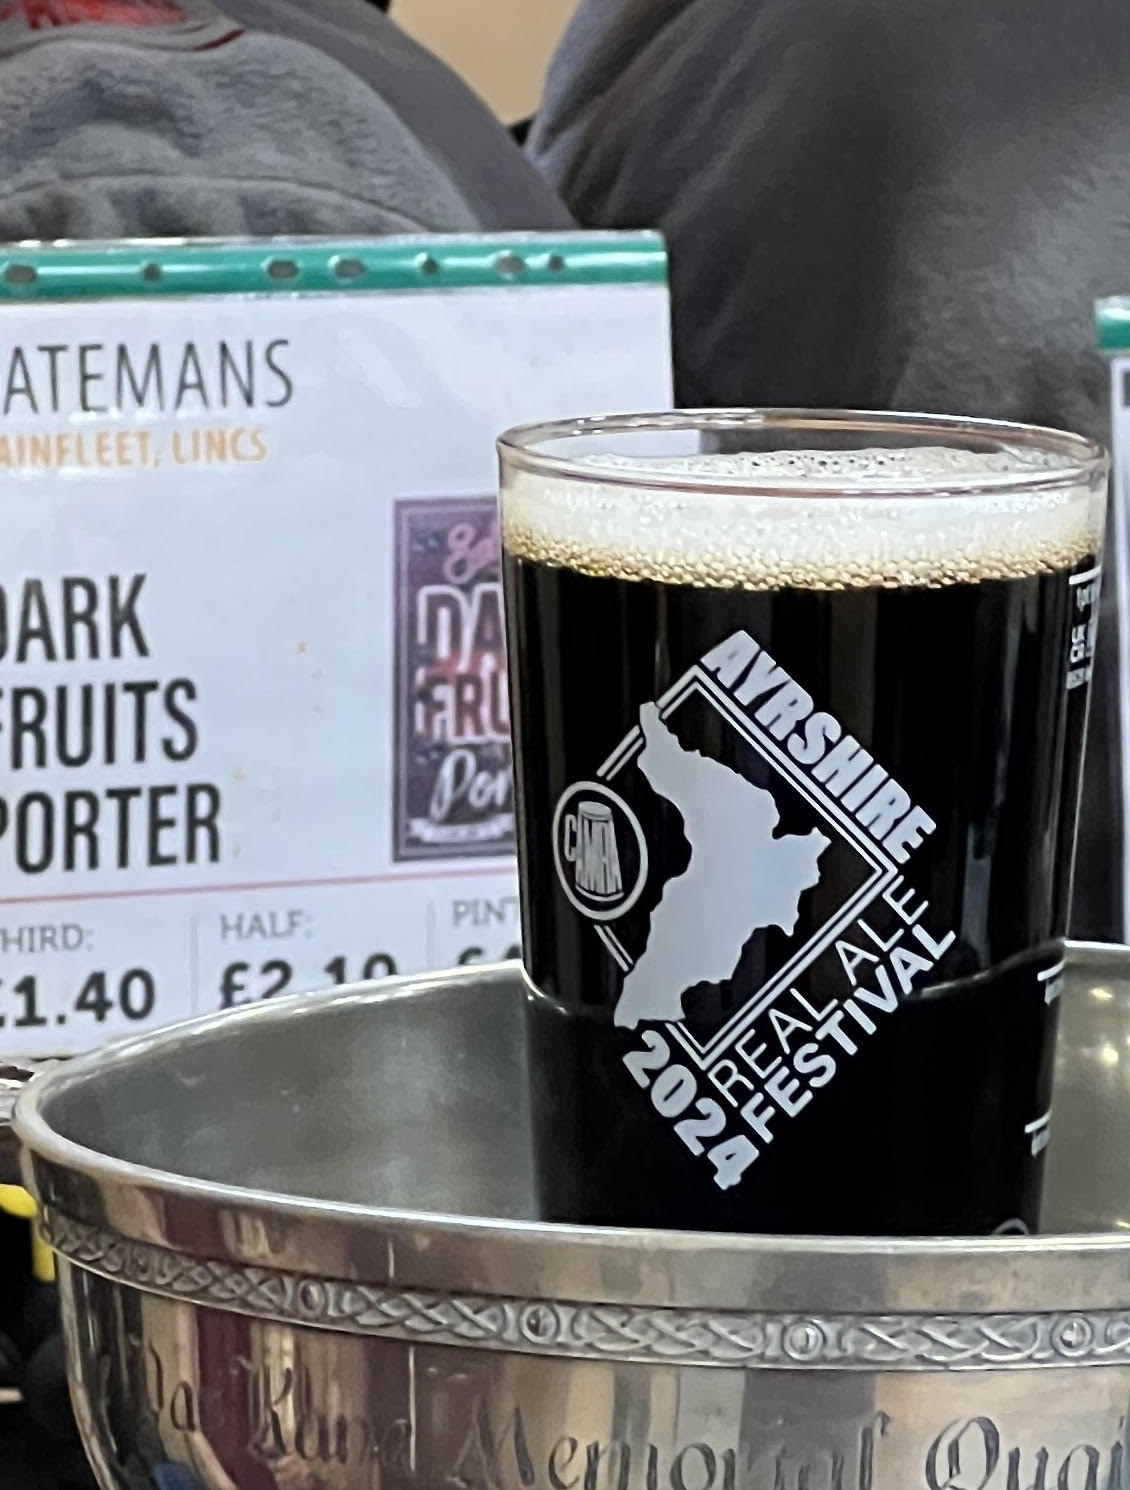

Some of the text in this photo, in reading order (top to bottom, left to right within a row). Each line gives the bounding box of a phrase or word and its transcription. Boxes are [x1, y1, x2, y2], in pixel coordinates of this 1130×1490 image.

[171, 427, 268, 465] LINCS
[0, 573, 151, 663] ARK
[701, 629, 937, 862] AYRSHIRE
[0, 782, 220, 875] ORTER
[219, 911, 313, 942] HALF:
[708, 875, 929, 1107] REAL ALE
[741, 929, 957, 1144] FESTIVAL
[621, 1030, 760, 1191] 2024
